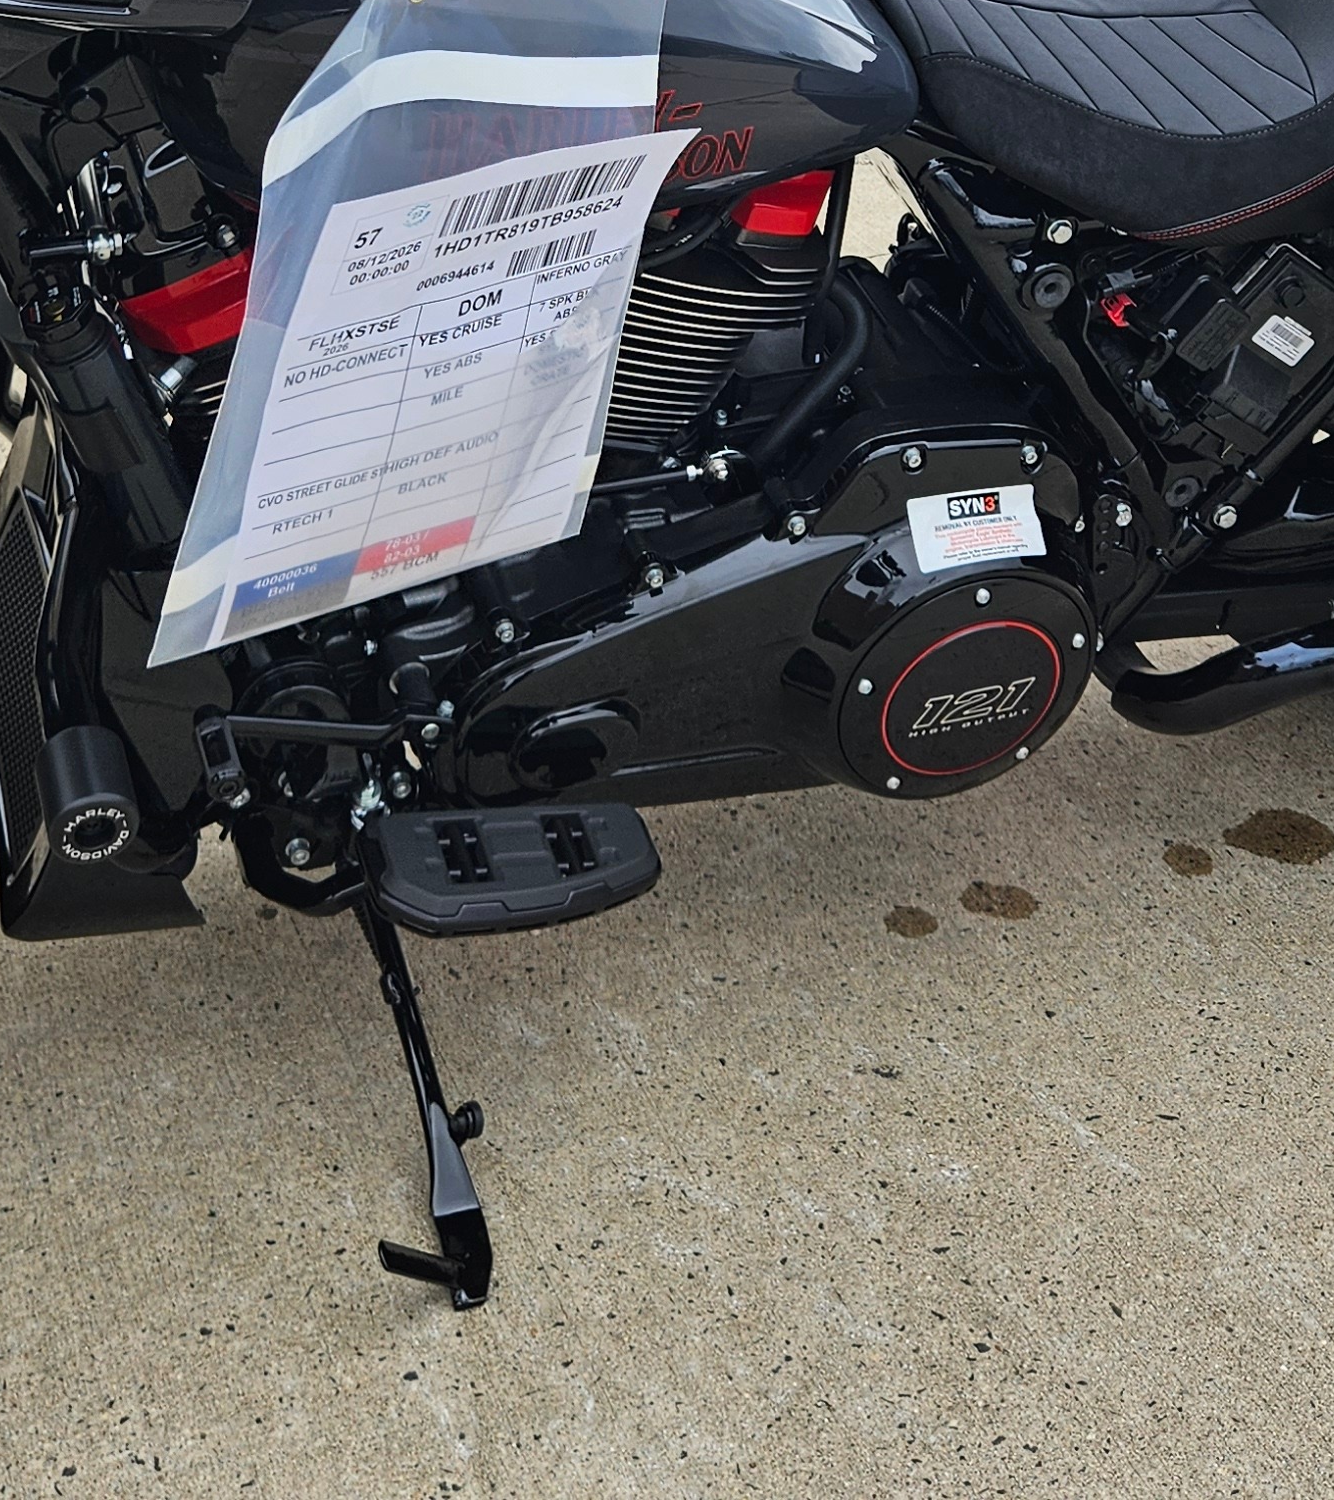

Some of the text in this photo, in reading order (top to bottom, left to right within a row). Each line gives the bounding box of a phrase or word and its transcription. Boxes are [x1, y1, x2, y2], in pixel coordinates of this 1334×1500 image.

[354, 227, 384, 250] 57
[434, 195, 624, 259] 1HD1TR819TB958624
[347, 240, 423, 272] 08/12/2026
[536, 250, 629, 285] INFERNO GRAY
[349, 259, 410, 286] 00:00:00
[416, 260, 496, 292] 0006944614
[457, 288, 503, 318] DOM
[548, 295, 573, 310] SPK
[308, 315, 401, 352] FLHXSTSE
[420, 314, 503, 348] YES CRUISE
[524, 331, 547, 348] YES
[323, 343, 349, 357] 2026
[283, 344, 409, 389] NO HD-CONNECT
[423, 352, 483, 380] YES ABS
[430, 385, 465, 407] MILE
[384, 431, 500, 474] HIGH DEF AUDIO
[258, 494, 284, 510] CVO
[286, 480, 332, 503] STREET
[334, 471, 368, 490] GLIDE
[397, 471, 449, 495] BLACK
[272, 512, 323, 535] RTECH
[253, 563, 318, 591] 40000036
[268, 582, 296, 599] Belt
[912, 676, 1037, 730] 121
[62, 830, 130, 861] DAVIDSON
